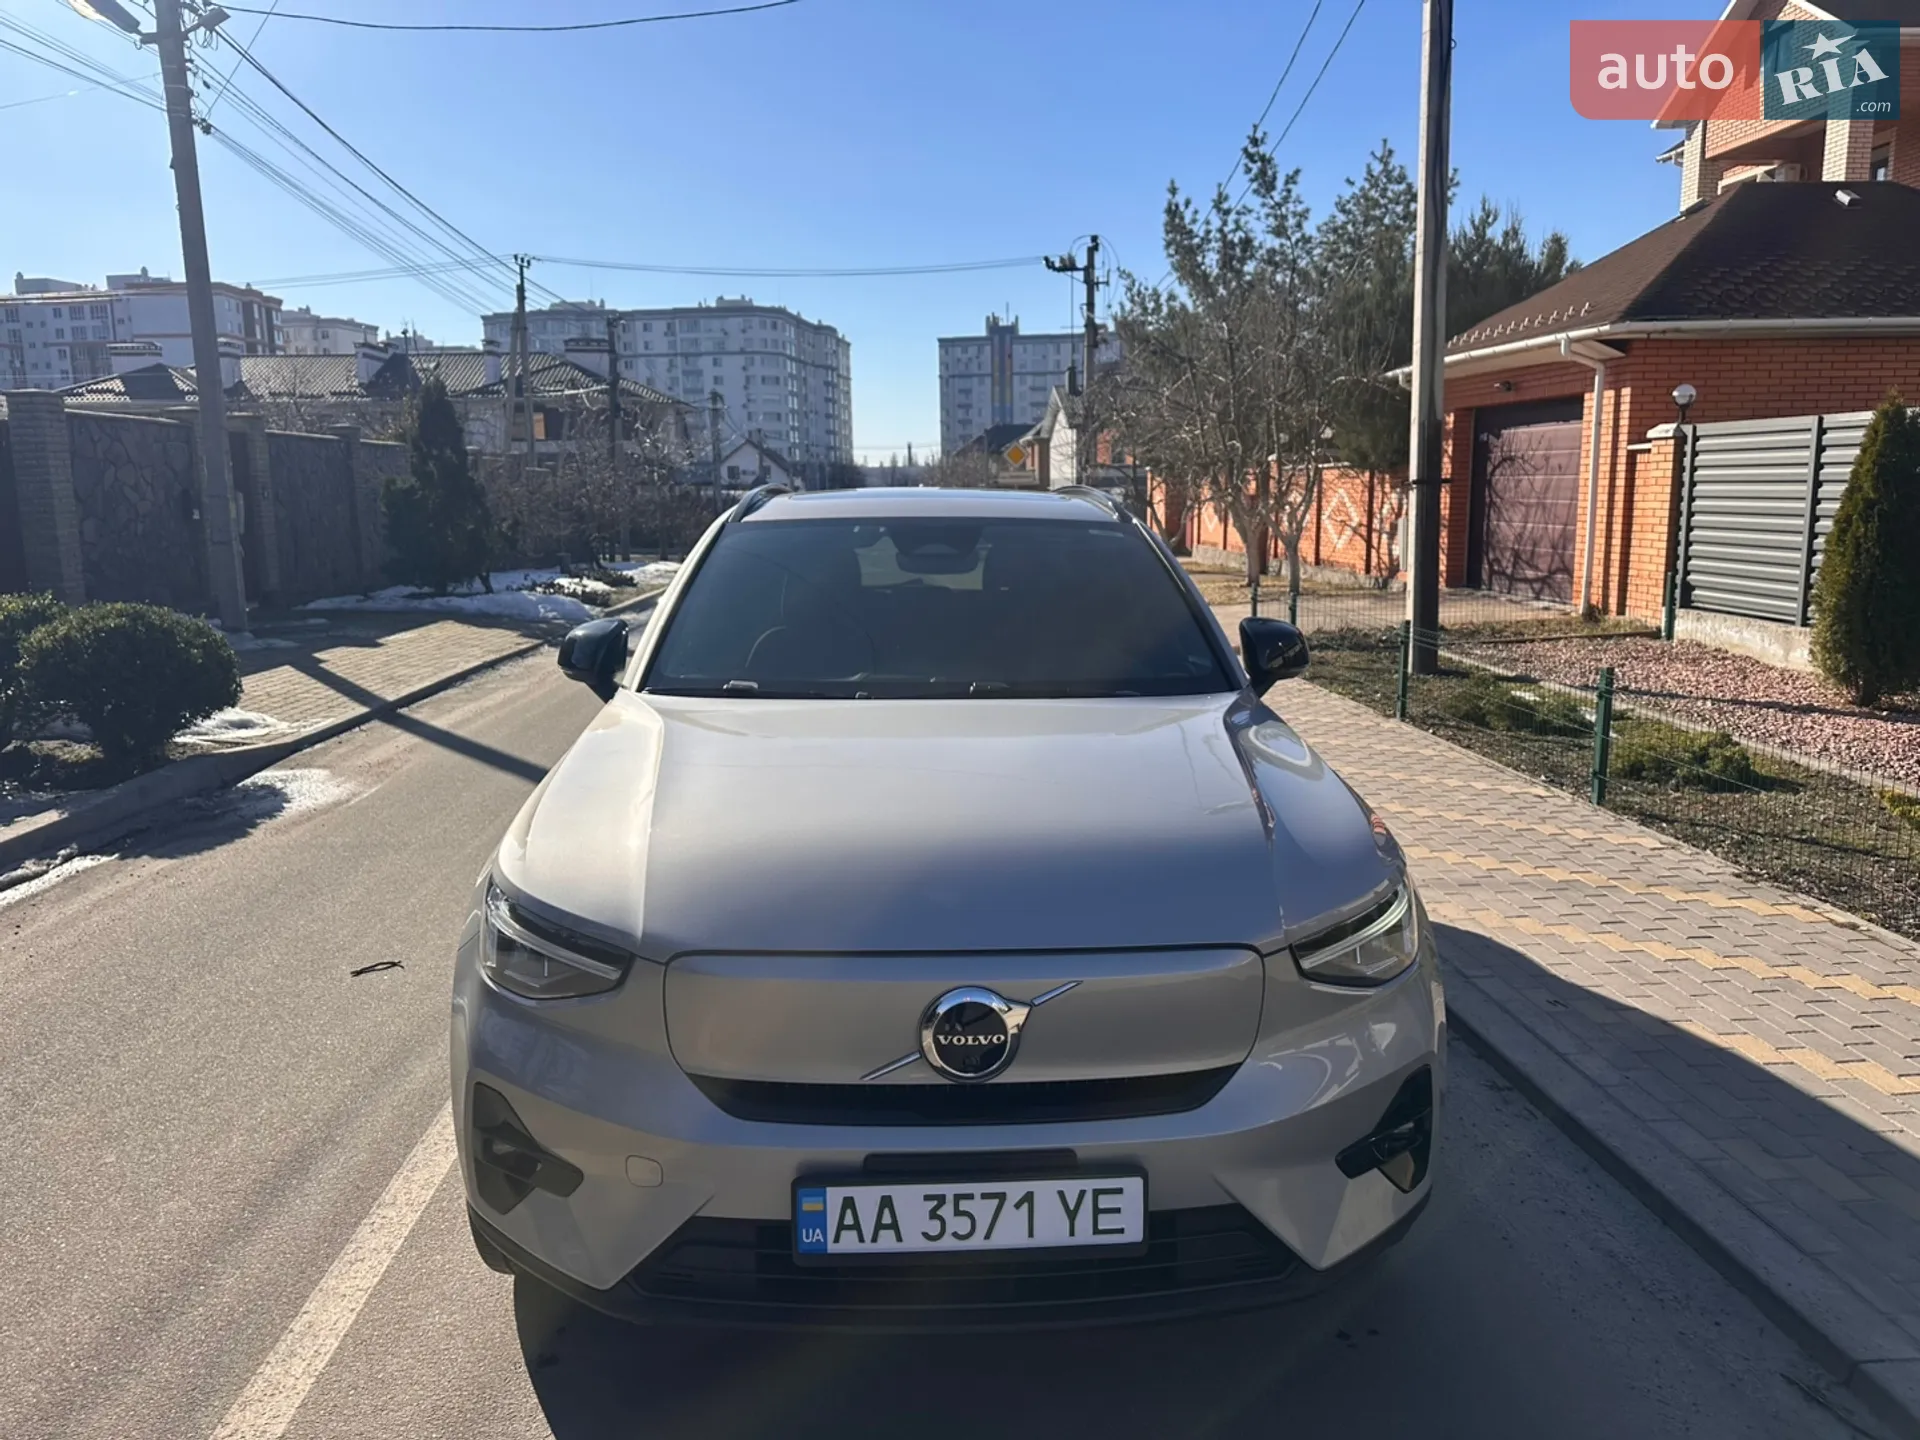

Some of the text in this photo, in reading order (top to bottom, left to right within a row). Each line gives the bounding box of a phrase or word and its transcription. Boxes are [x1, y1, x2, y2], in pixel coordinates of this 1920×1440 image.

[936, 1034, 1006, 1046] VOLVO
[832, 1186, 1126, 1244] AA 3571 YE
[802, 1228, 825, 1243] UA
